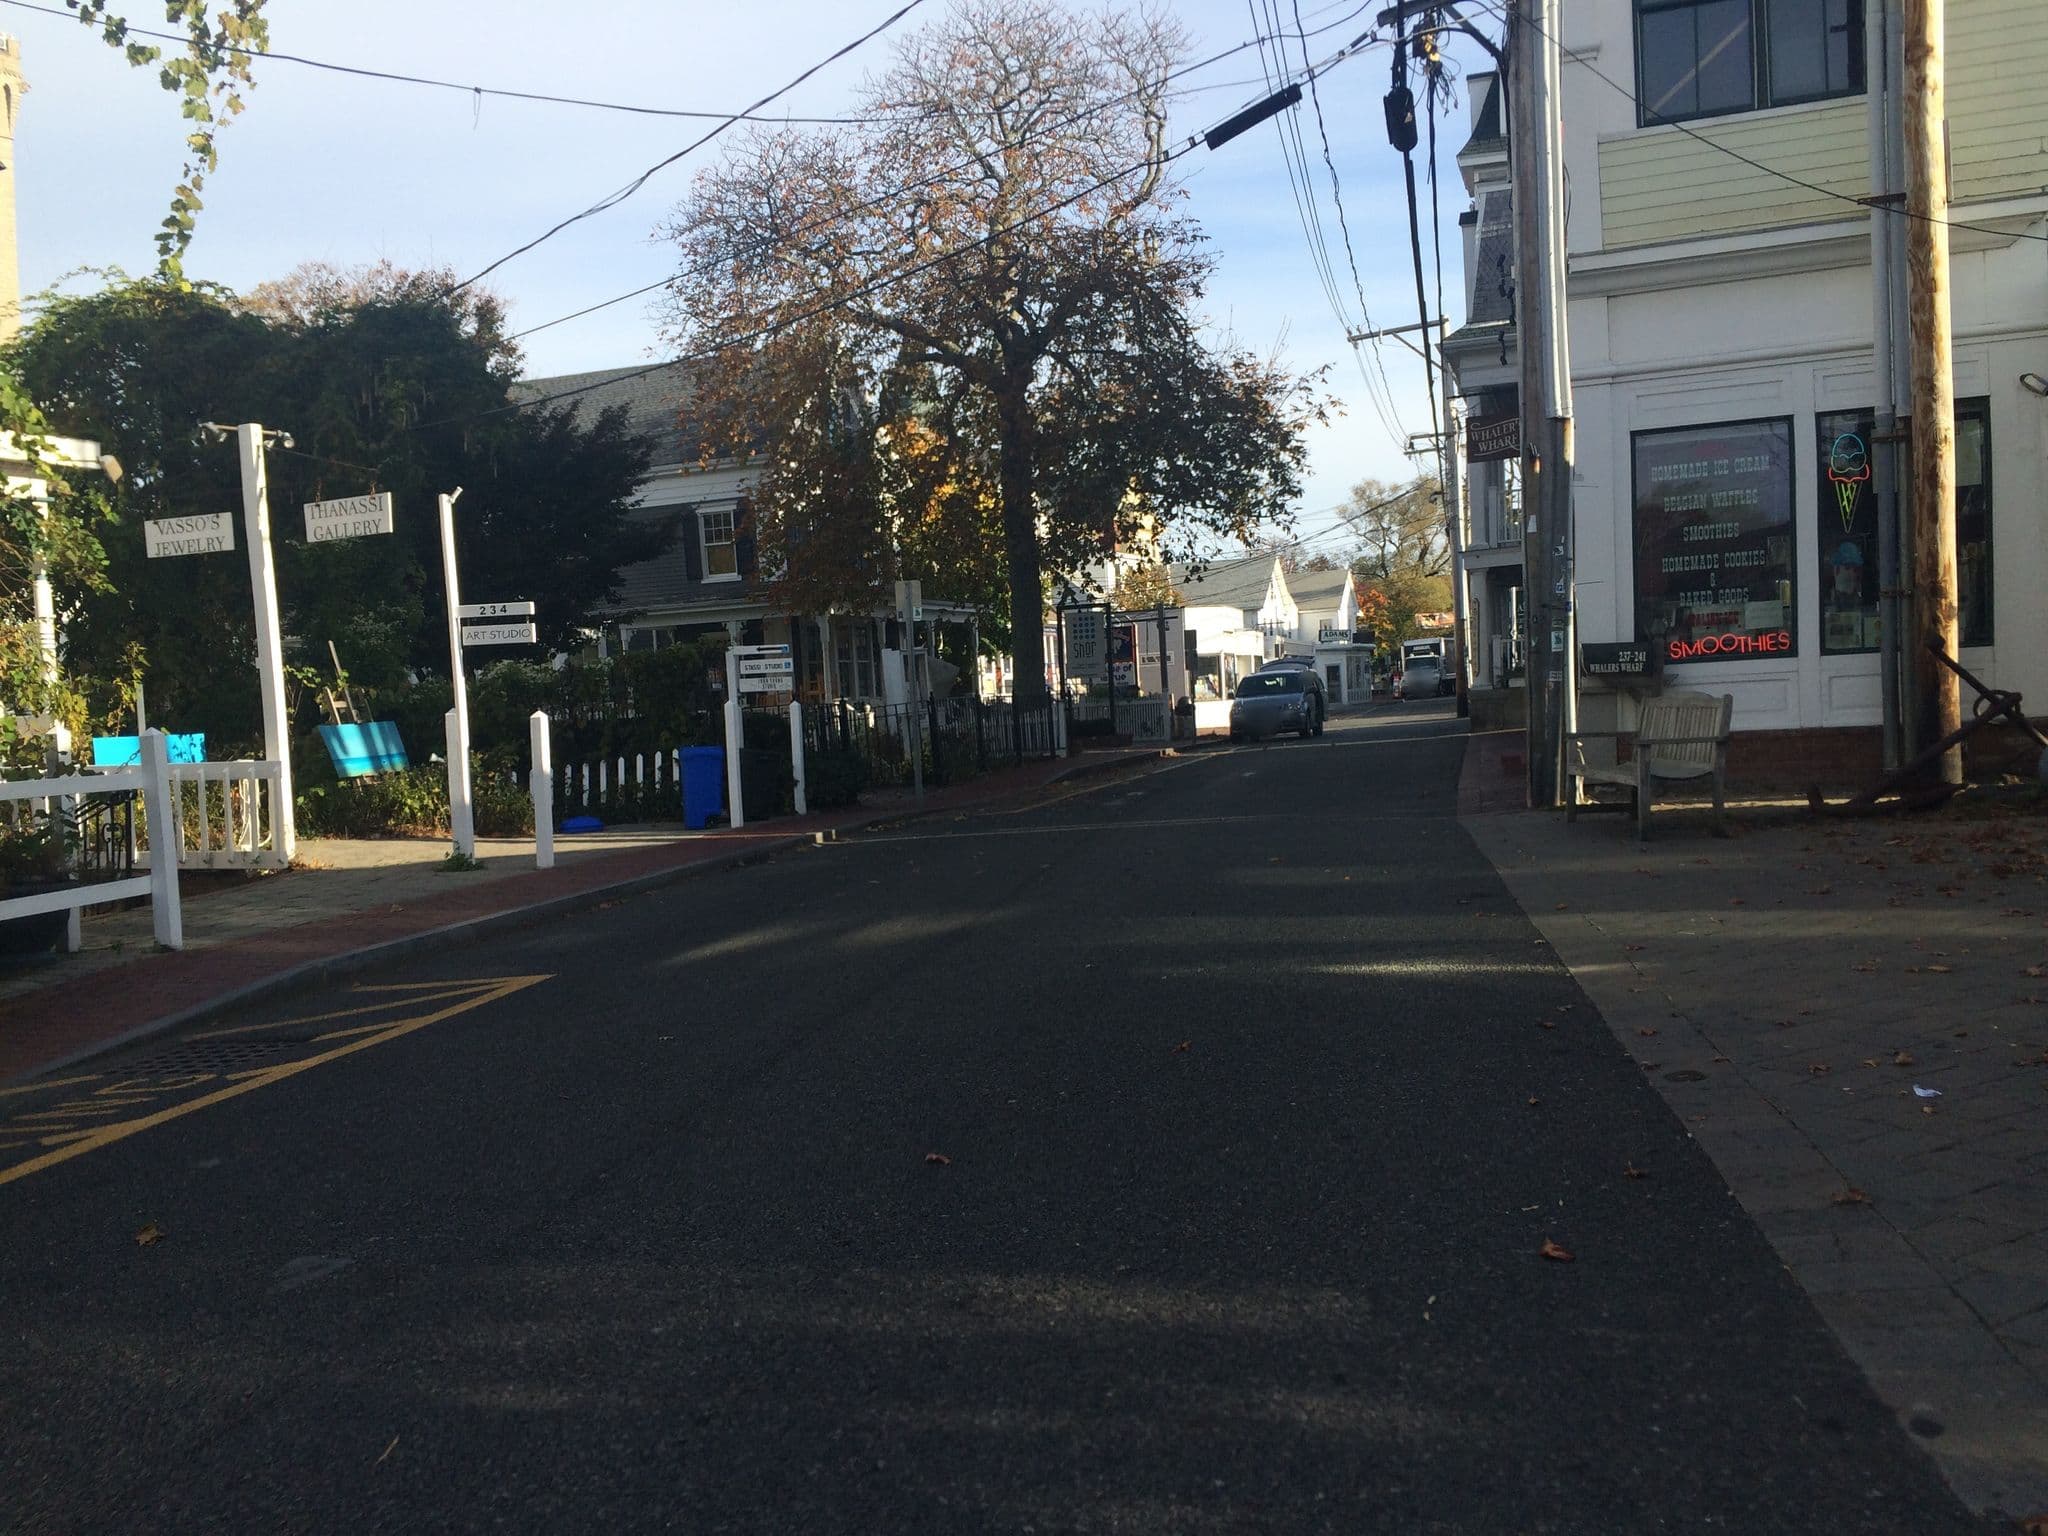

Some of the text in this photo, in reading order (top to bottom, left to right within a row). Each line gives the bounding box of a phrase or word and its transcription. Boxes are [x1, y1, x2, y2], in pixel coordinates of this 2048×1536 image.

[1473, 420, 1520, 441] WHALER'
[1478, 434, 1519, 453] WHARF
[1651, 455, 1770, 481] HOMEMADE ICE CREAM
[309, 496, 384, 519] THANASSI
[1663, 488, 1760, 512] BELGIAN WAFFLES
[154, 515, 221, 535] VASSO'S
[313, 518, 382, 540] GALLERY
[1682, 522, 1740, 541] SMOOTHIES
[154, 536, 226, 556] JEWELRY
[1662, 550, 1766, 572] HOMEMADE COOKIES
[1680, 588, 1750, 607] BAKED GOODS
[466, 628, 531, 641] ART STUDIO
[1324, 630, 1349, 638] ADAMS
[1669, 632, 1790, 658] SMOOTHIES
[1618, 651, 1647, 662] 237-241
[1589, 663, 1644, 673] WHALERS WHARF
